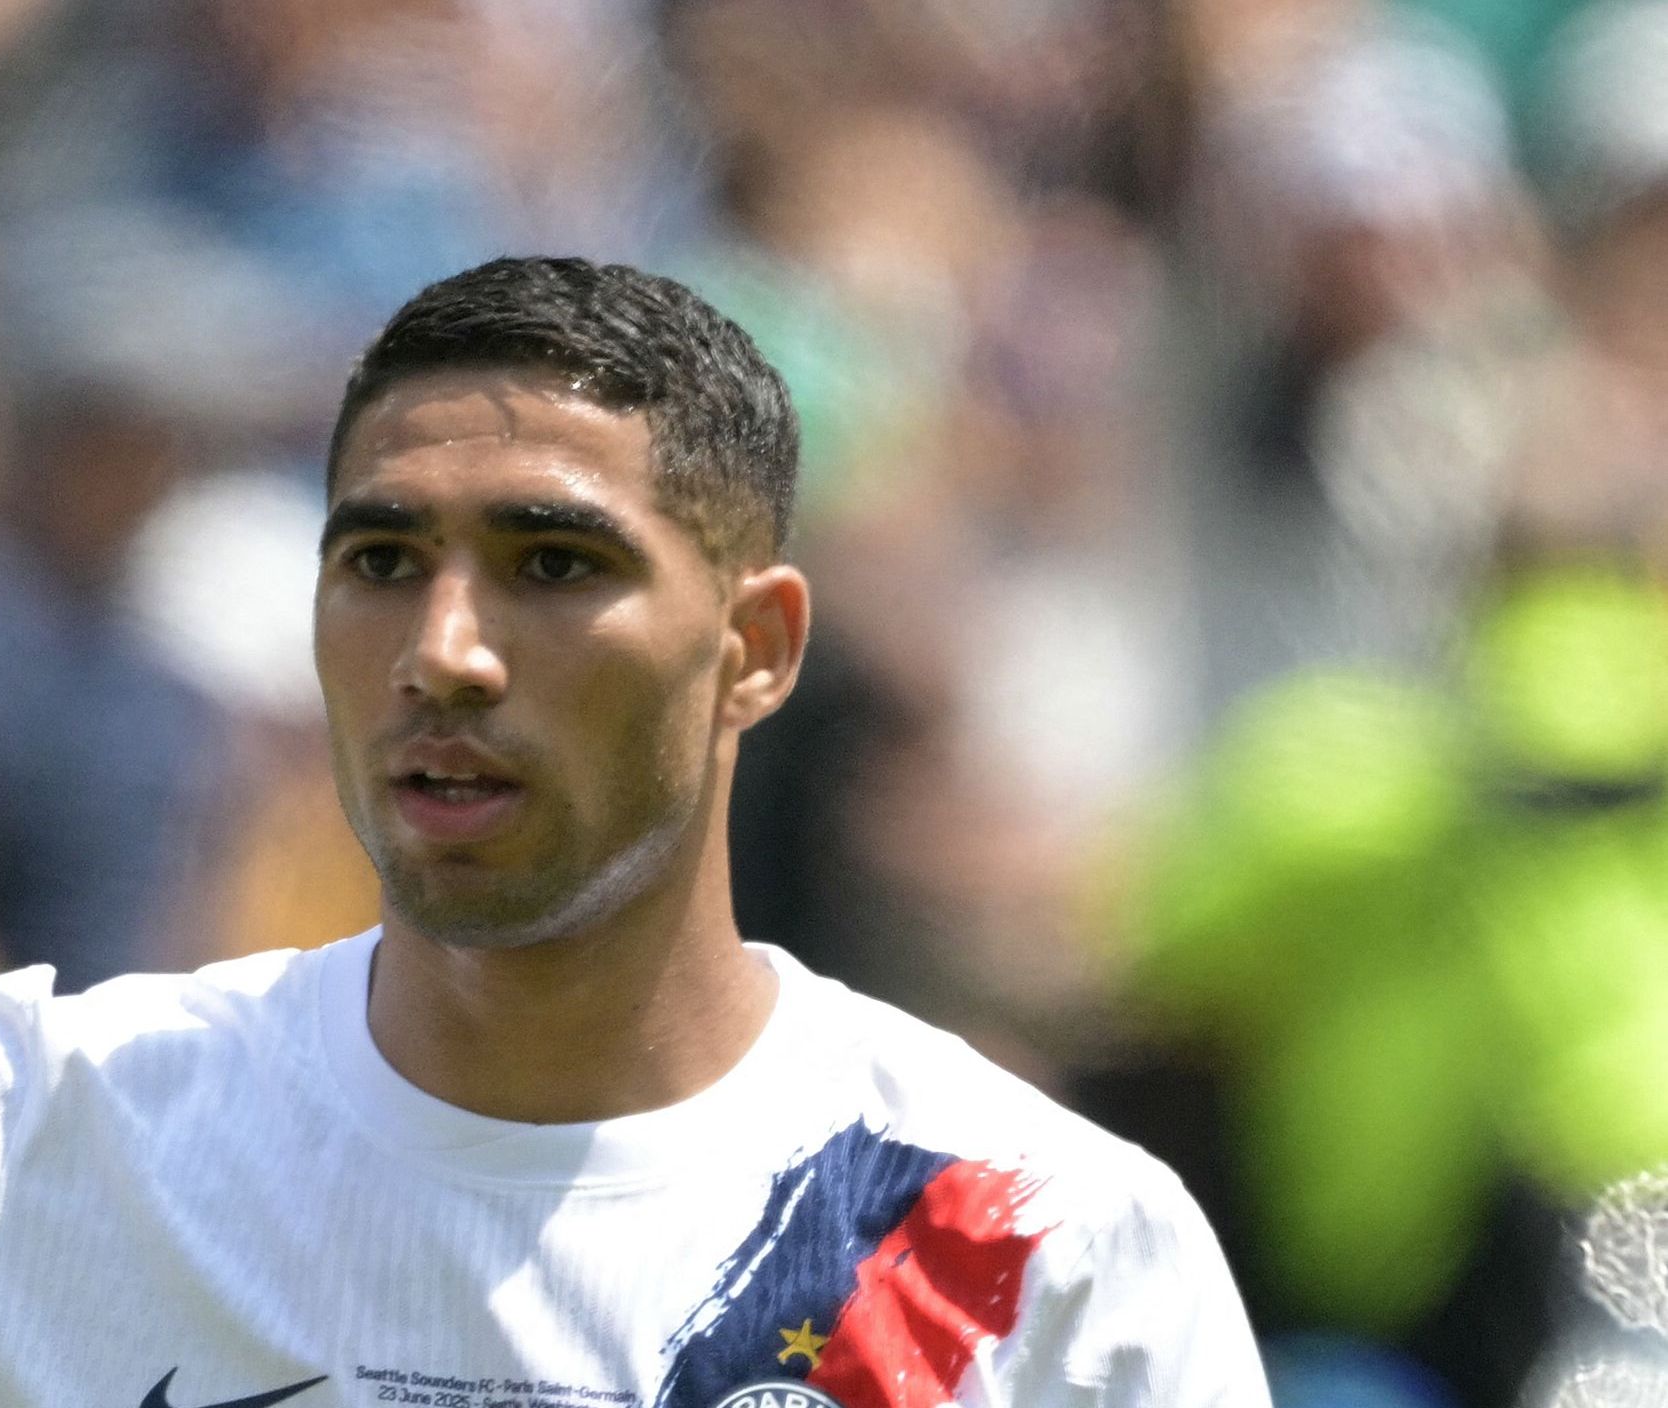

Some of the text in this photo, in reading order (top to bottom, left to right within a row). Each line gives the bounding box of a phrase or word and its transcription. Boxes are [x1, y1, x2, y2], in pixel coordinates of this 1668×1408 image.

[356, 1364, 408, 1384] Seattle
[411, 1371, 476, 1393] Sounders
[478, 1378, 495, 1394] FC
[504, 1379, 534, 1394] Paris
[378, 1385, 396, 1401] 23
[399, 1387, 431, 1405] June
